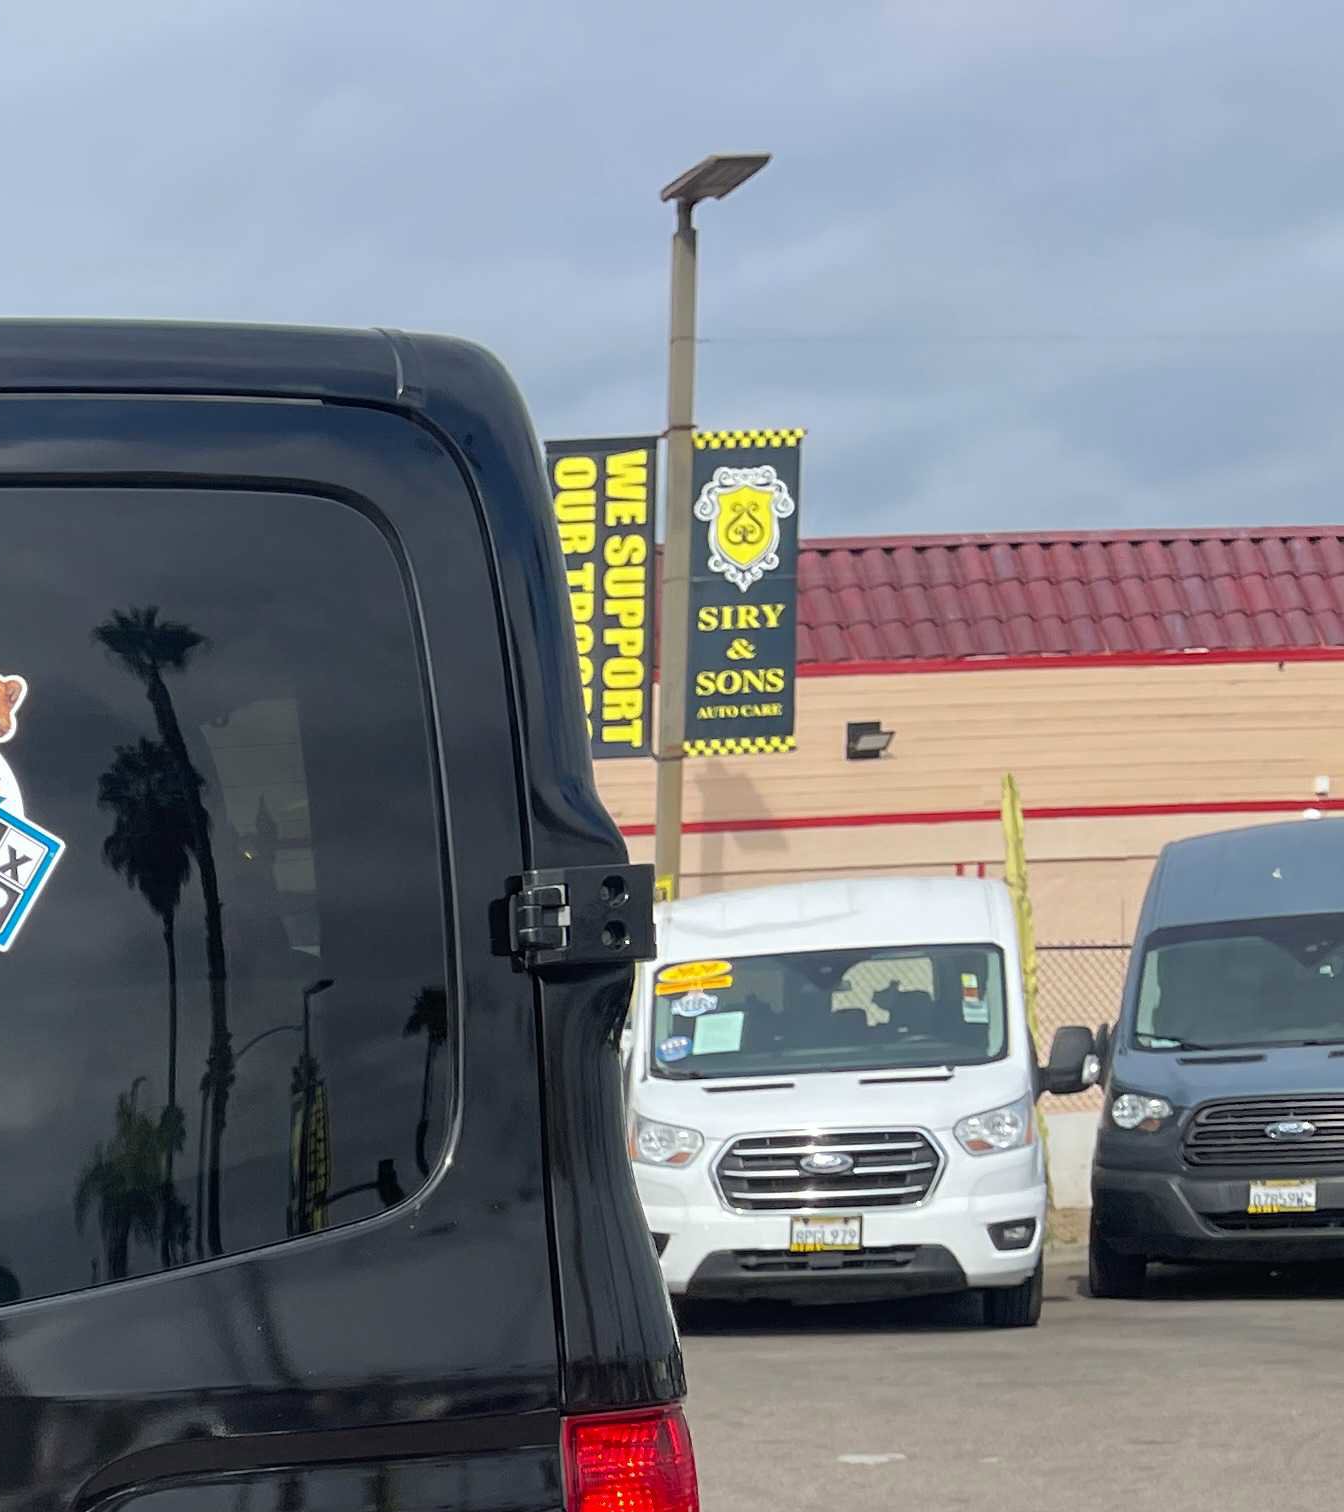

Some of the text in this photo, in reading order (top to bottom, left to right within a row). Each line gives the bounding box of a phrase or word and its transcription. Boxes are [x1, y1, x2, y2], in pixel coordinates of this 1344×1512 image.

[554, 456, 597, 555] OUR
[602, 449, 648, 748] WE SUPPORT
[697, 603, 786, 632] SIRY
[726, 638, 757, 661] &
[695, 668, 785, 697] SONS
[696, 702, 783, 719] AUTO CARE
